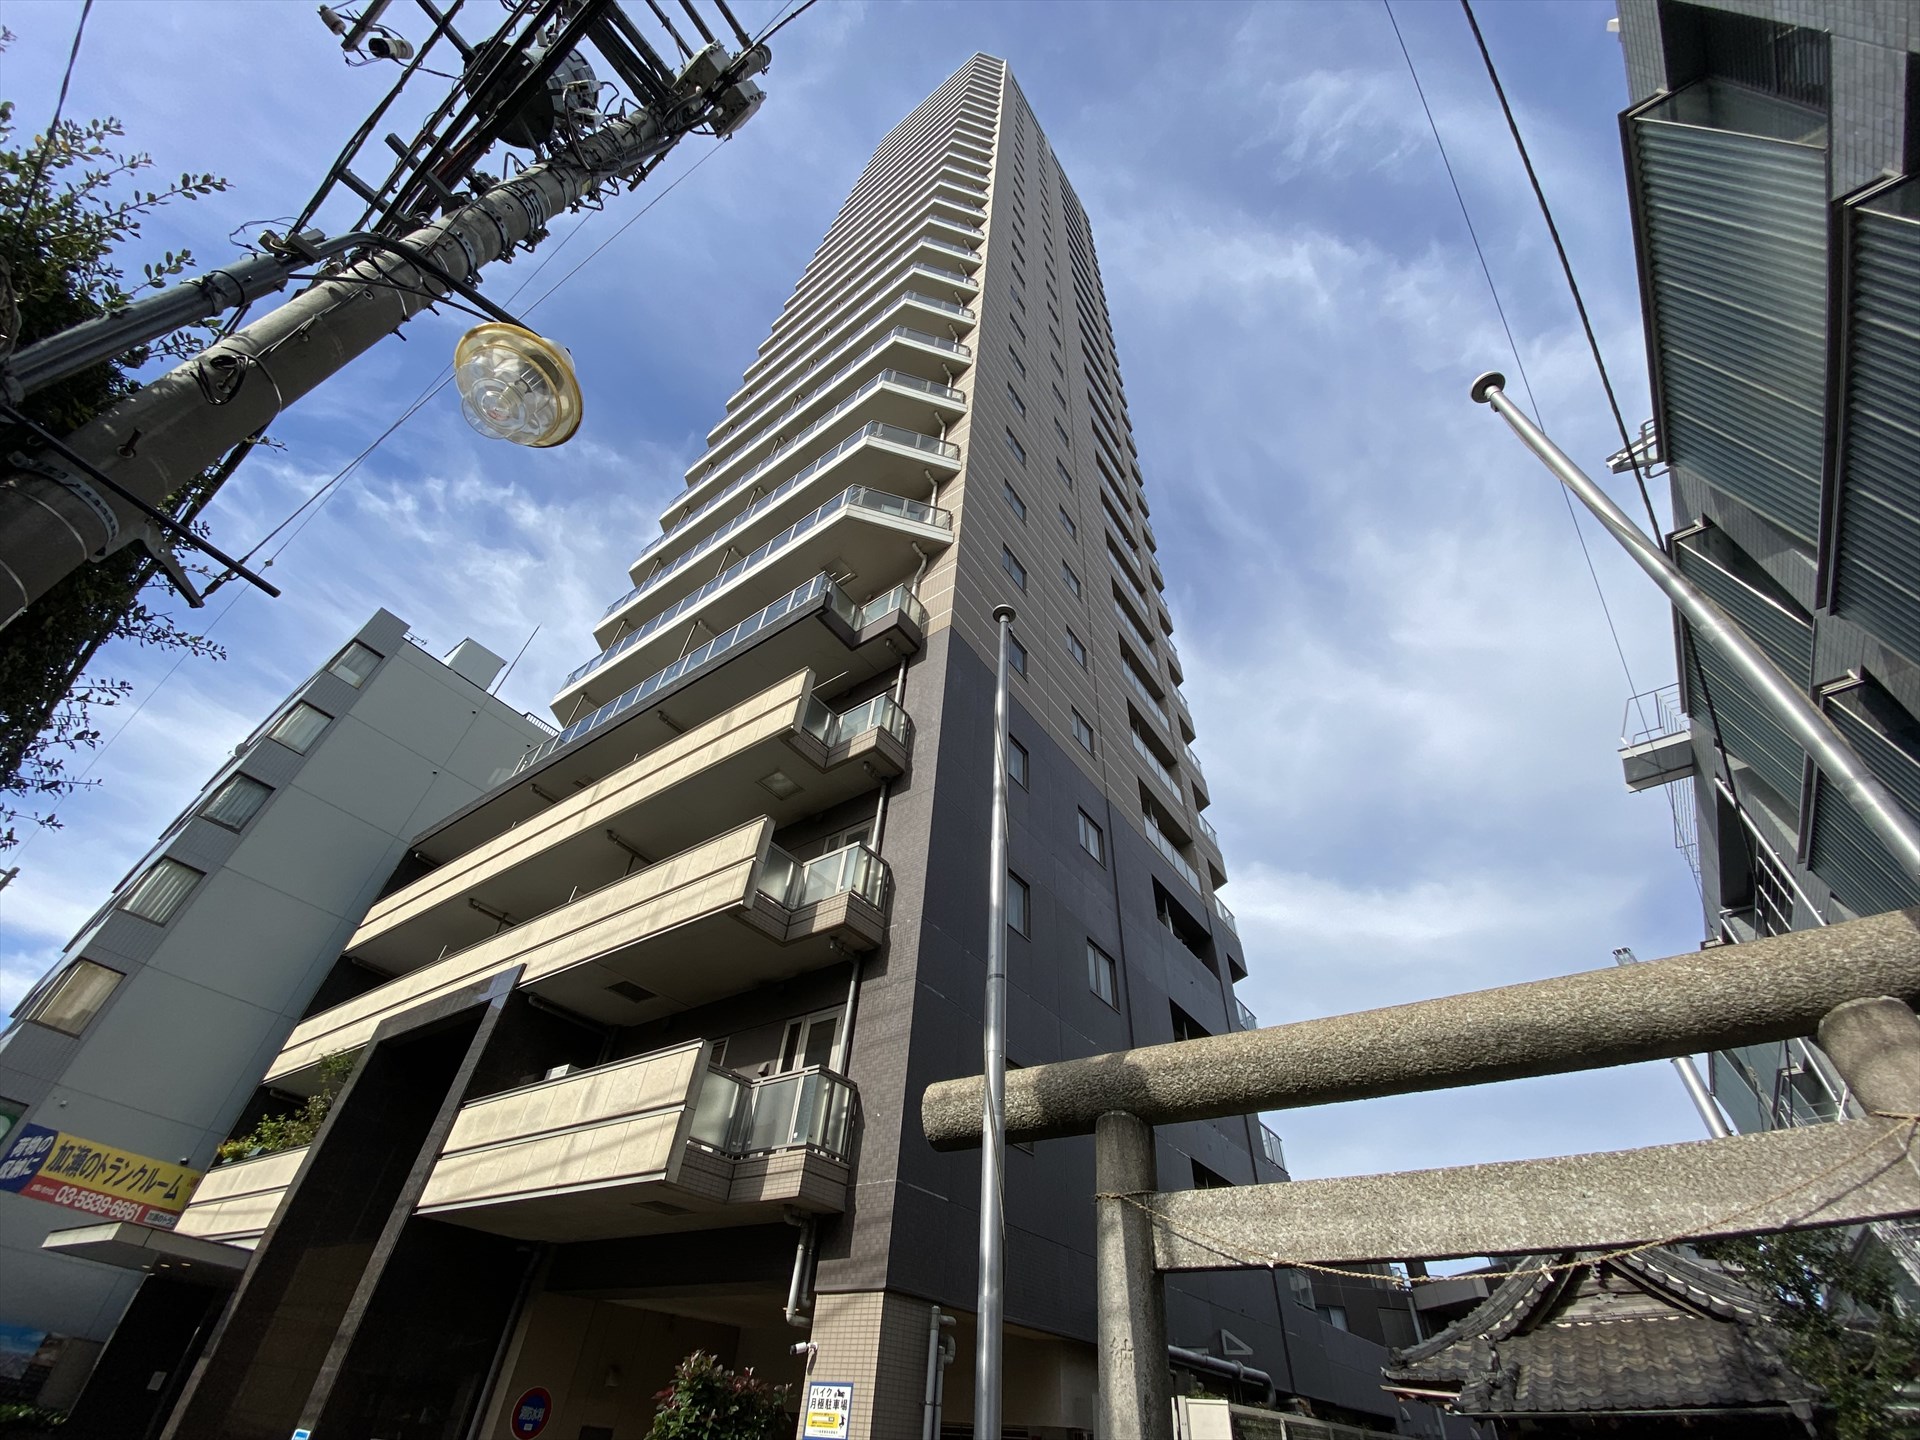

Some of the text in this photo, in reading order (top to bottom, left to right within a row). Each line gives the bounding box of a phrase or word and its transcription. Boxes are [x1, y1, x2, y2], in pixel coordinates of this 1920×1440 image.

[46, 1139, 184, 1201] 加瀬のトランクルーム
[812, 1387, 833, 1398] バイク
[809, 1397, 848, 1411] 月極駐車場
